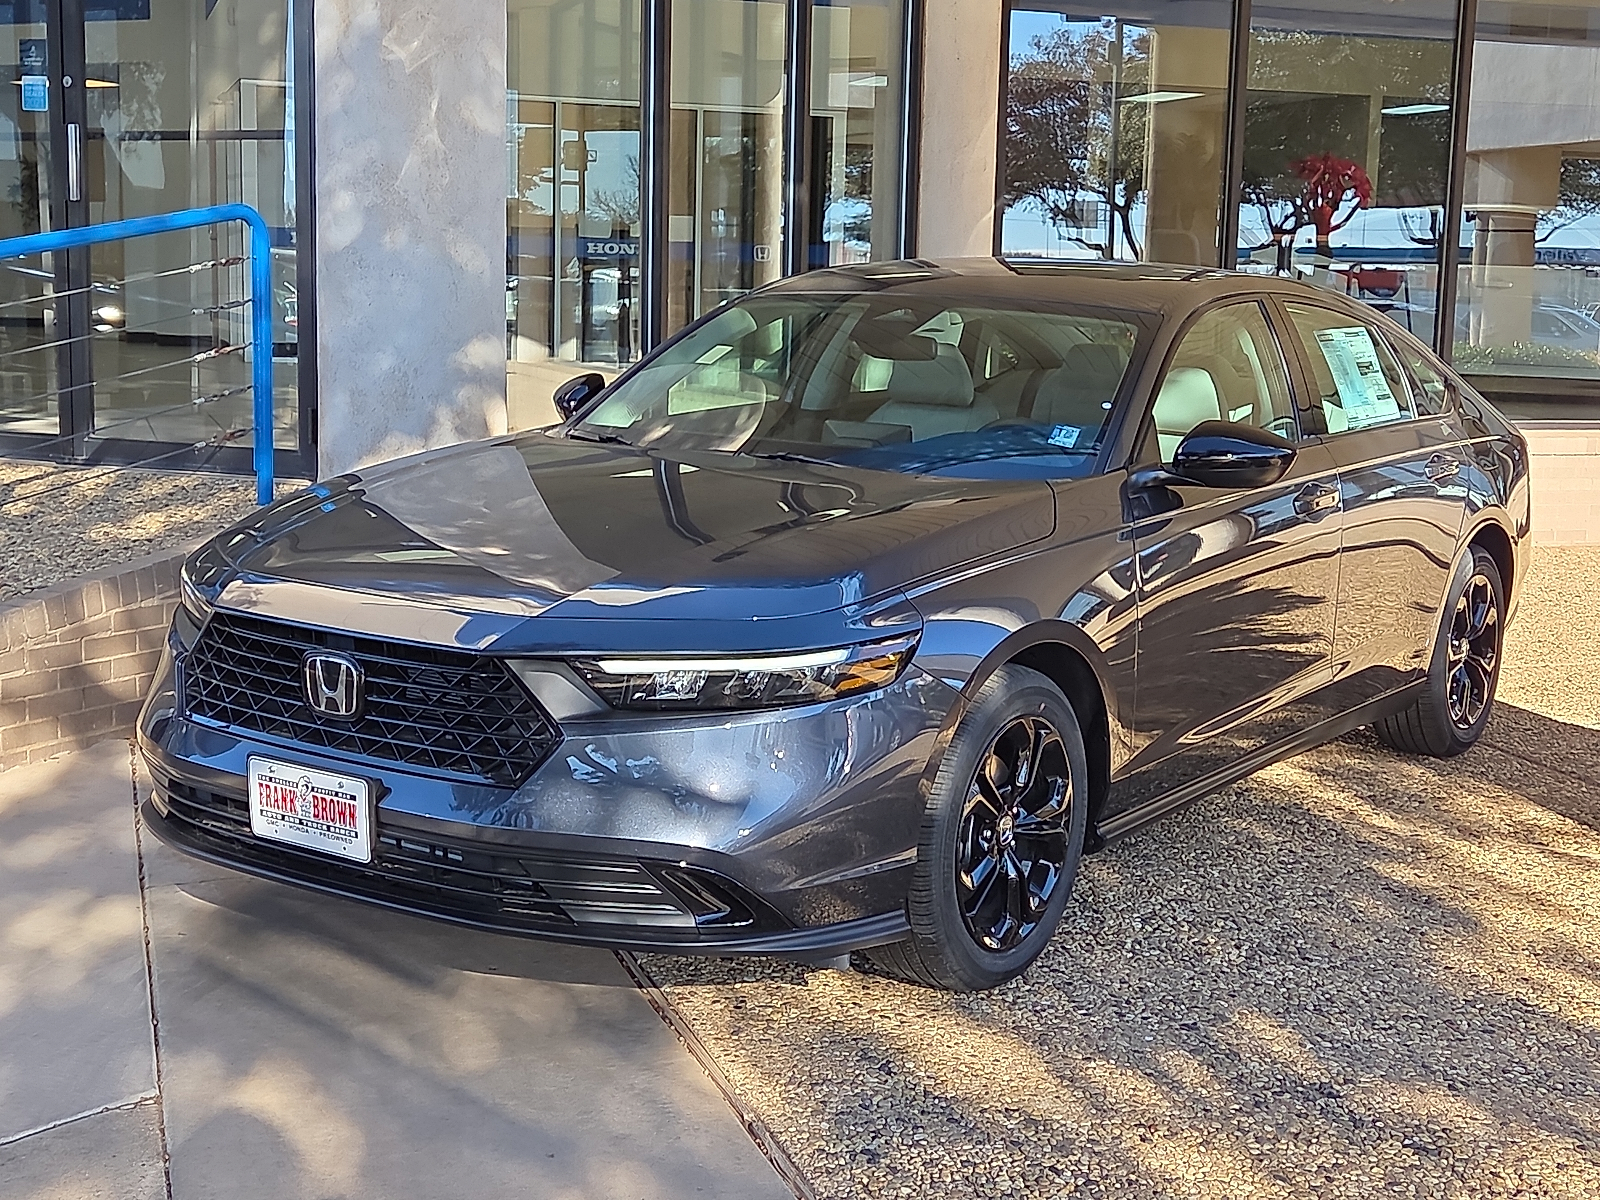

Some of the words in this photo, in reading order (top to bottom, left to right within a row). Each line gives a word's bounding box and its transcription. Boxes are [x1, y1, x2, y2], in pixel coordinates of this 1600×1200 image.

[587, 242, 639, 255] HON
[258, 782, 298, 814] FRANK
[312, 794, 357, 829] BROWN
[262, 810, 283, 820] AUTO
[284, 815, 300, 824] AND
[302, 820, 328, 831] TRUCK
[329, 826, 356, 837] RANCH
[266, 818, 279, 827] GMC
[289, 824, 310, 834] HONDA
[319, 831, 353, 844] PREOWNED
